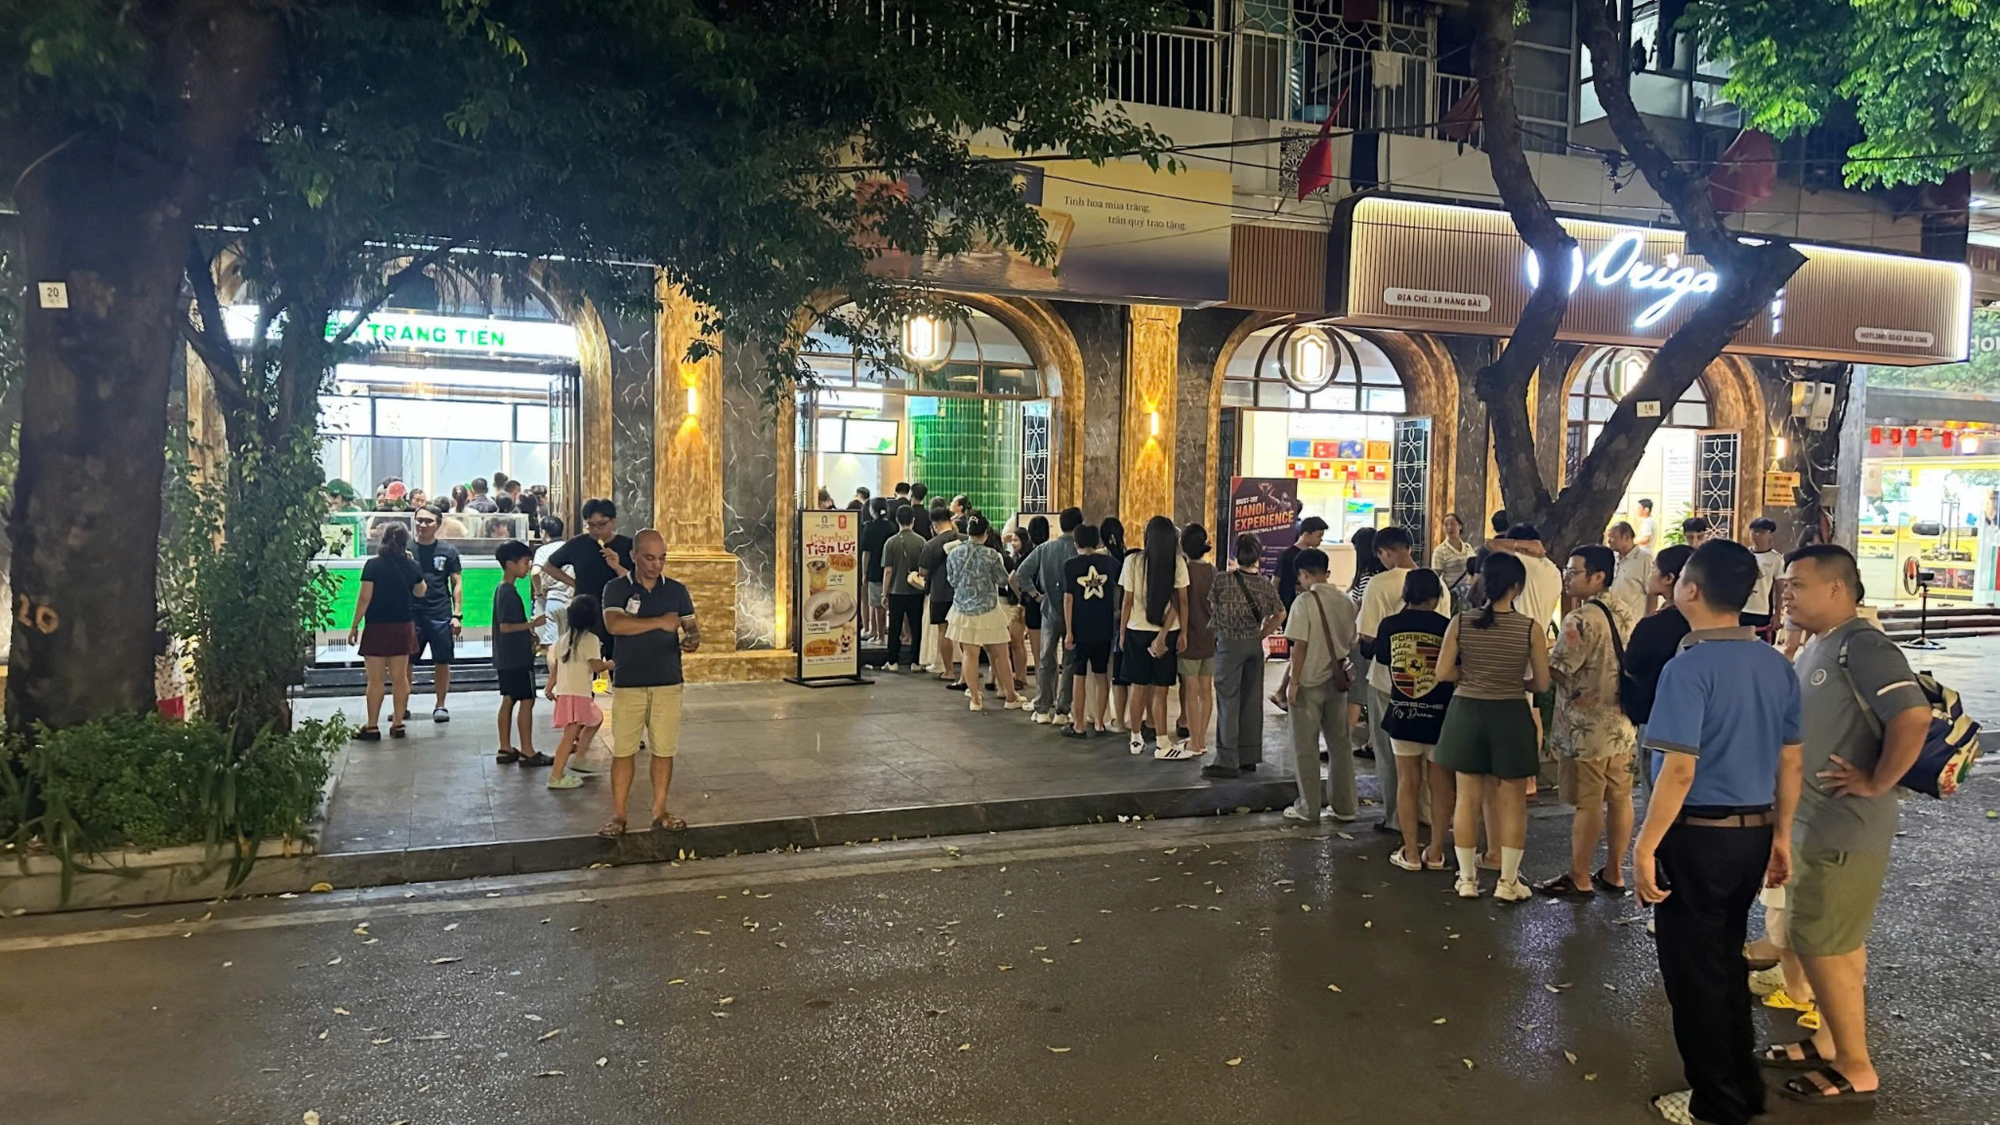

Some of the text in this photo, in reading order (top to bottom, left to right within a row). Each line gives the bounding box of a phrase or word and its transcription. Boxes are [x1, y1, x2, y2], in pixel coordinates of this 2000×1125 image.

[1087, 198, 1103, 208] hoa
[1146, 218, 1164, 228] trao
[1586, 230, 1719, 328] Origa
[46, 287, 60, 298] 20
[1433, 296, 1442, 304] 18
[1444, 296, 1466, 306] HÀNG
[1644, 403, 1654, 411] 18
[1235, 502, 1265, 518] HANOI
[1234, 510, 1294, 532] EXPERIENCE
